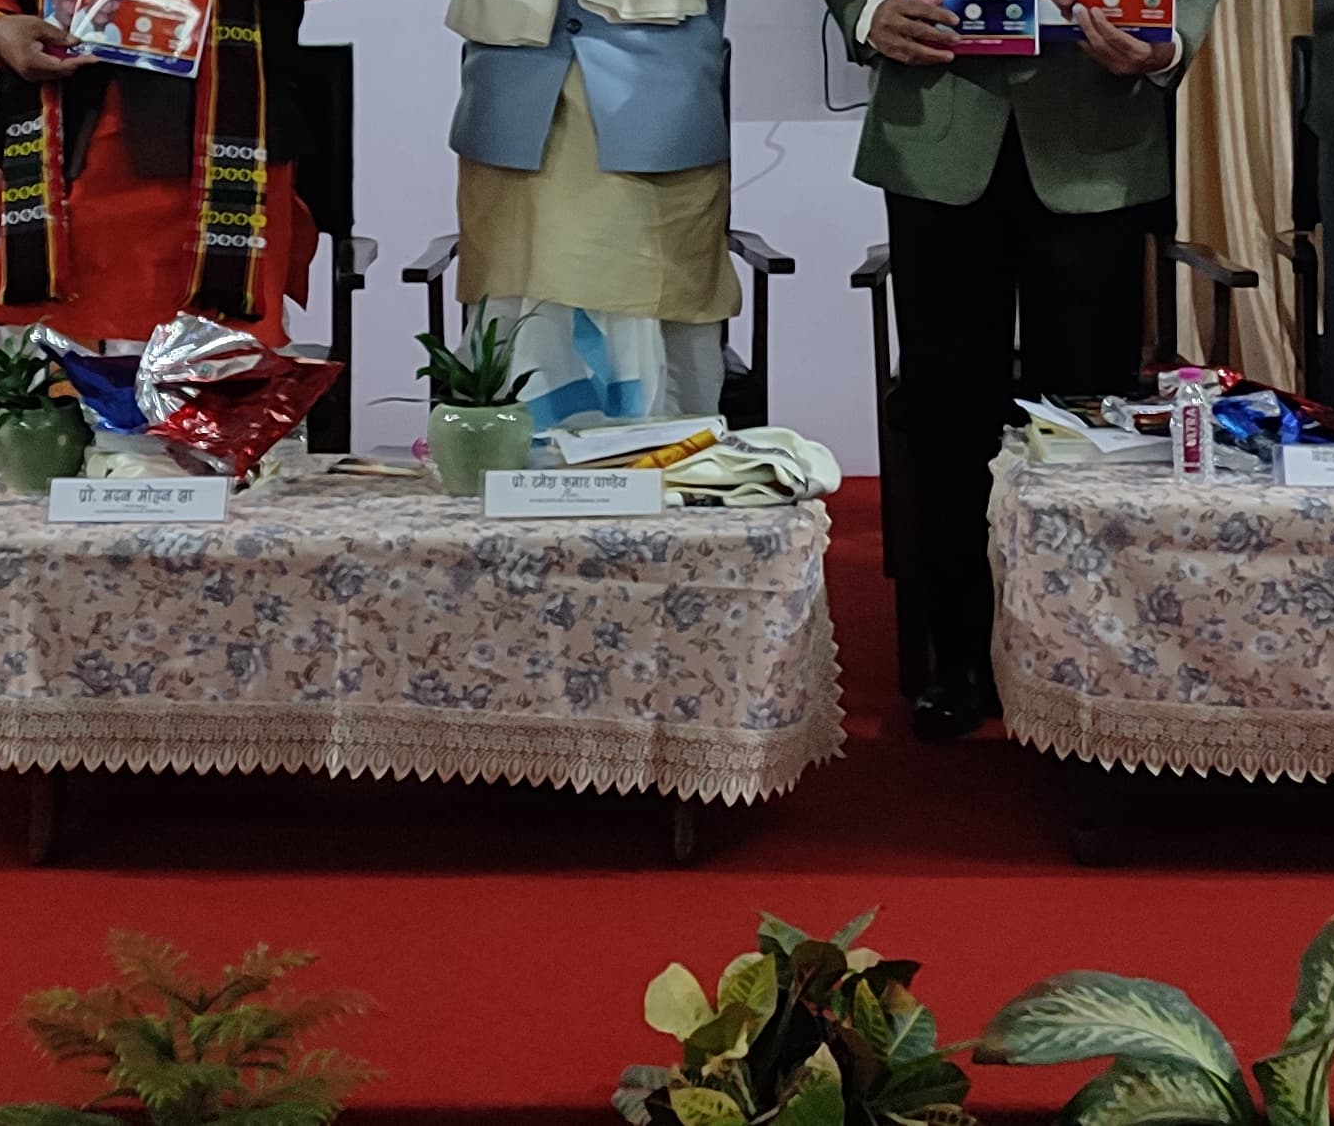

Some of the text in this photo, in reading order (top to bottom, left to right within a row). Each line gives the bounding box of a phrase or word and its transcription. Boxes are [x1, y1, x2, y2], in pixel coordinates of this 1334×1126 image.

[561, 475, 591, 491] कुमार
[77, 484, 196, 505] प्रो. मदन मोहन झा
